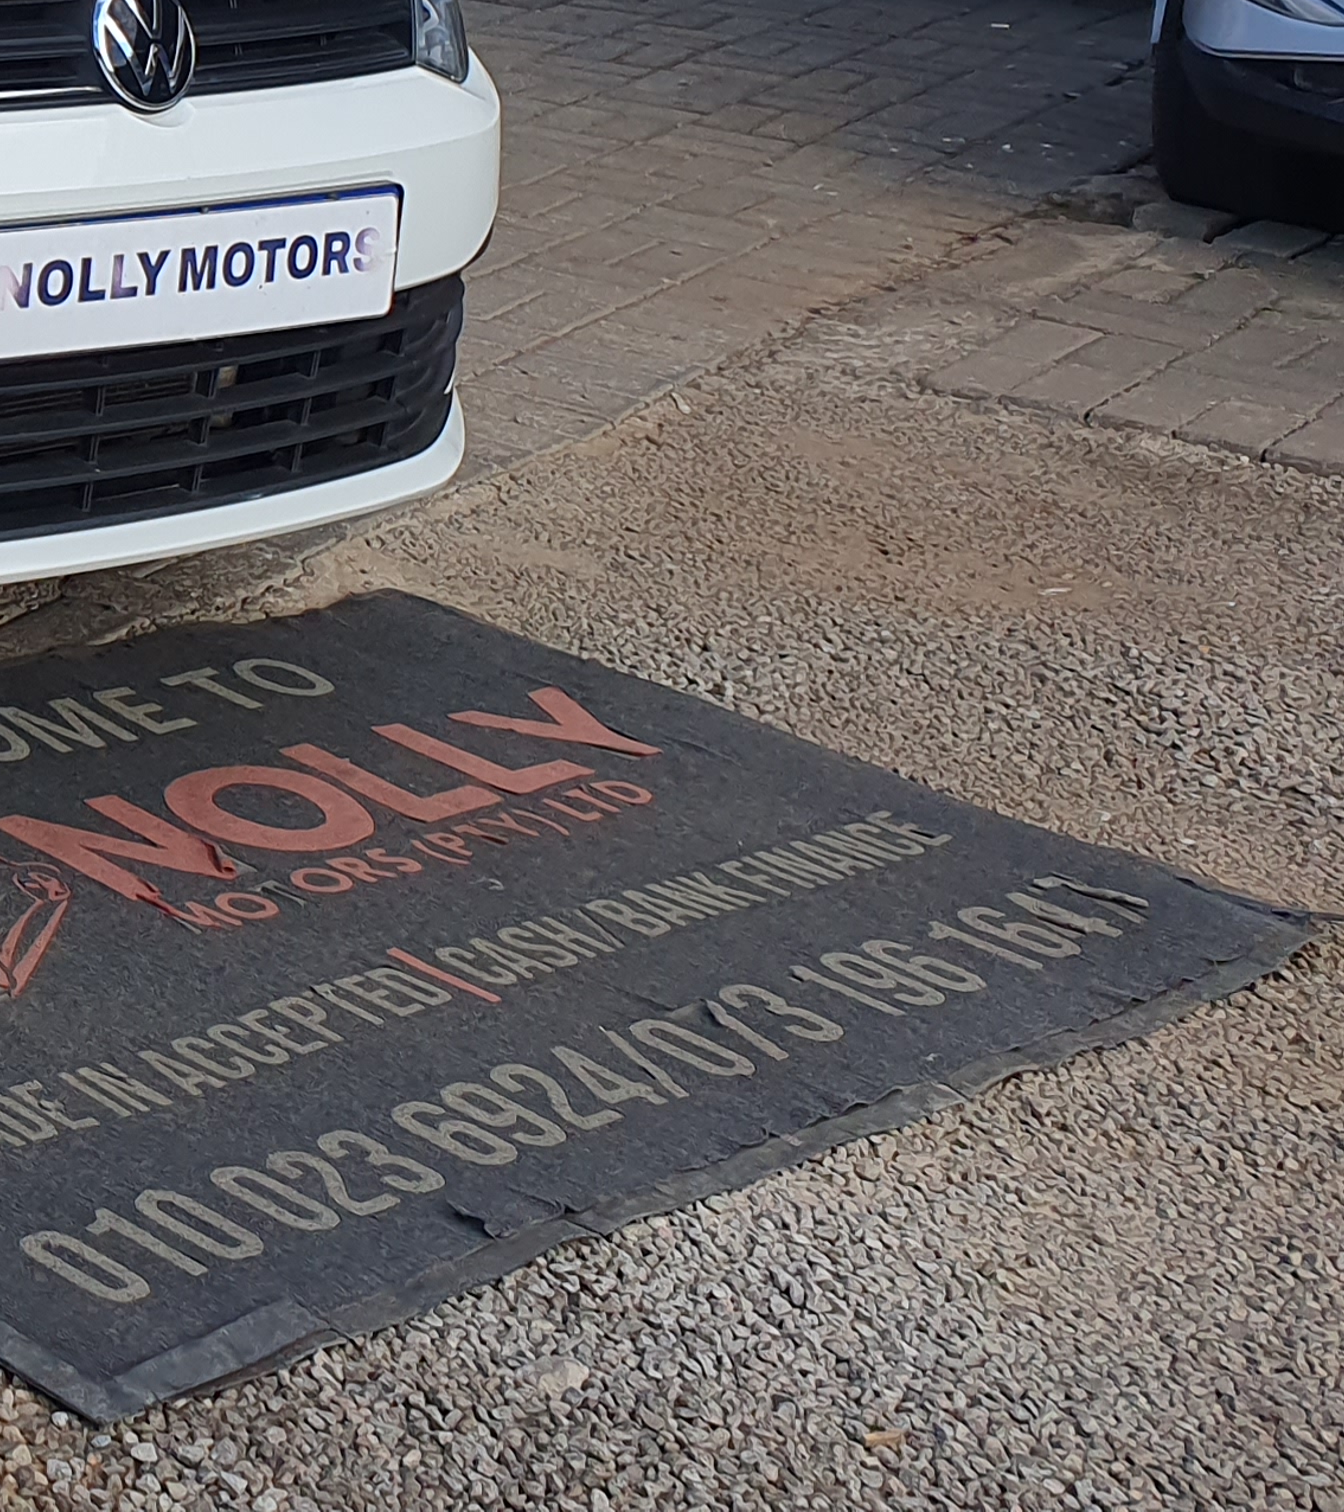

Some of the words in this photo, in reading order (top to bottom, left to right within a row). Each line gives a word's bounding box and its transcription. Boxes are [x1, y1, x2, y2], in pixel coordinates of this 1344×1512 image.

[0, 250, 171, 310] NOLLY
[177, 227, 381, 292] MOTORS
[161, 657, 335, 710] TO
[542, 779, 653, 822] LTD
[58, 1061, 173, 1119] IN
[138, 966, 454, 1097] ACCEPTED
[719, 810, 953, 898] FINANCE
[19, 1188, 265, 1304] 010
[210, 1128, 447, 1232] 023
[789, 938, 988, 1016] 196
